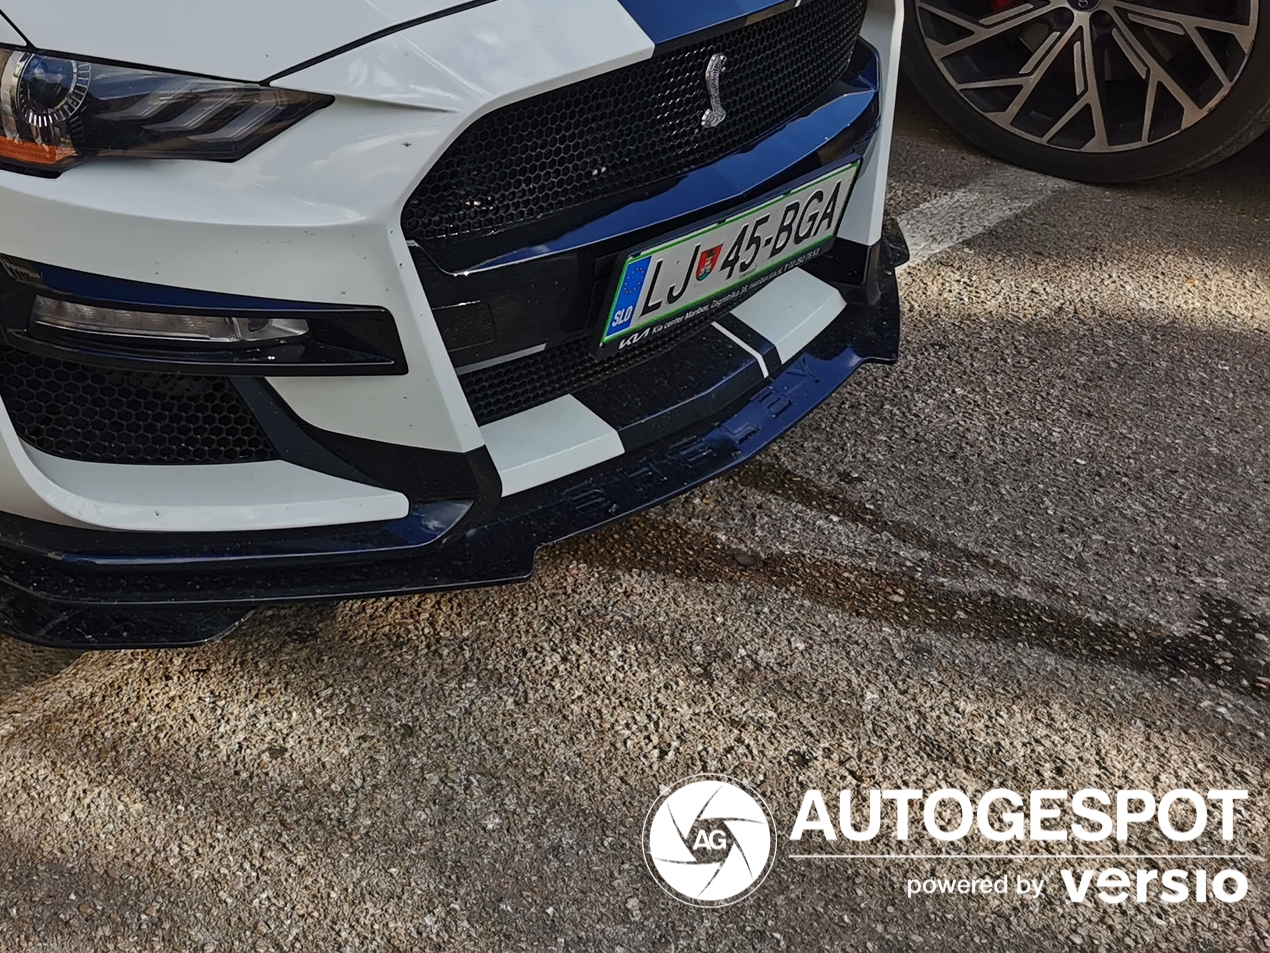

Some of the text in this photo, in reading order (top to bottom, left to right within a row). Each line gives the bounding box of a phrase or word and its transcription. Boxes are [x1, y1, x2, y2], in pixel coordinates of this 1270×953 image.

[638, 179, 842, 318] LJ 45-BGA
[611, 305, 634, 327] SLO
[651, 324, 663, 335] Kia
